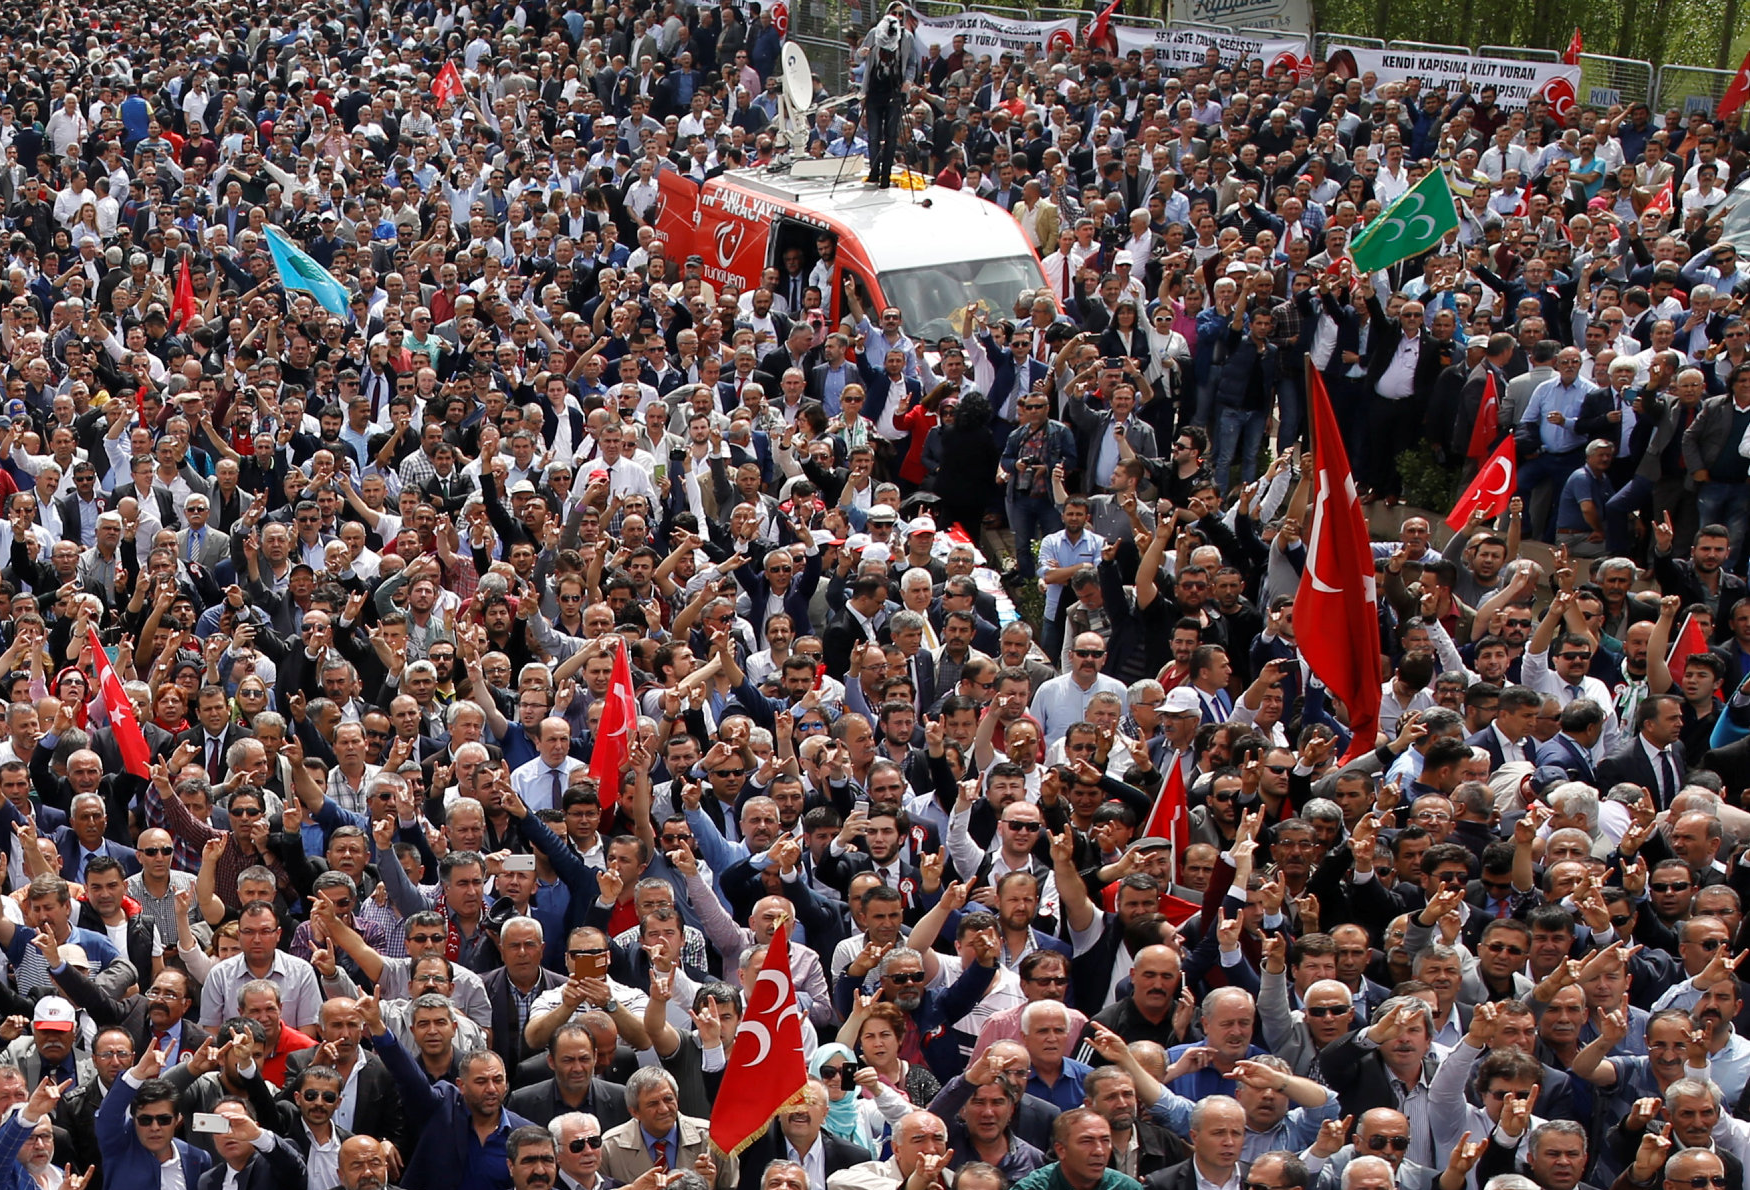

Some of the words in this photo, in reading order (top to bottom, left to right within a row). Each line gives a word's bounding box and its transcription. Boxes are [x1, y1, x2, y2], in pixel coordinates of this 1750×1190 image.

[1172, 47, 1190, 62] İSTE
[1382, 54, 1415, 70] KENDİ
[1418, 57, 1467, 73] KAPISINA
[1470, 60, 1497, 77] KİLİT
[1500, 65, 1536, 80] VURAN
[1590, 90, 1619, 105] POLİS
